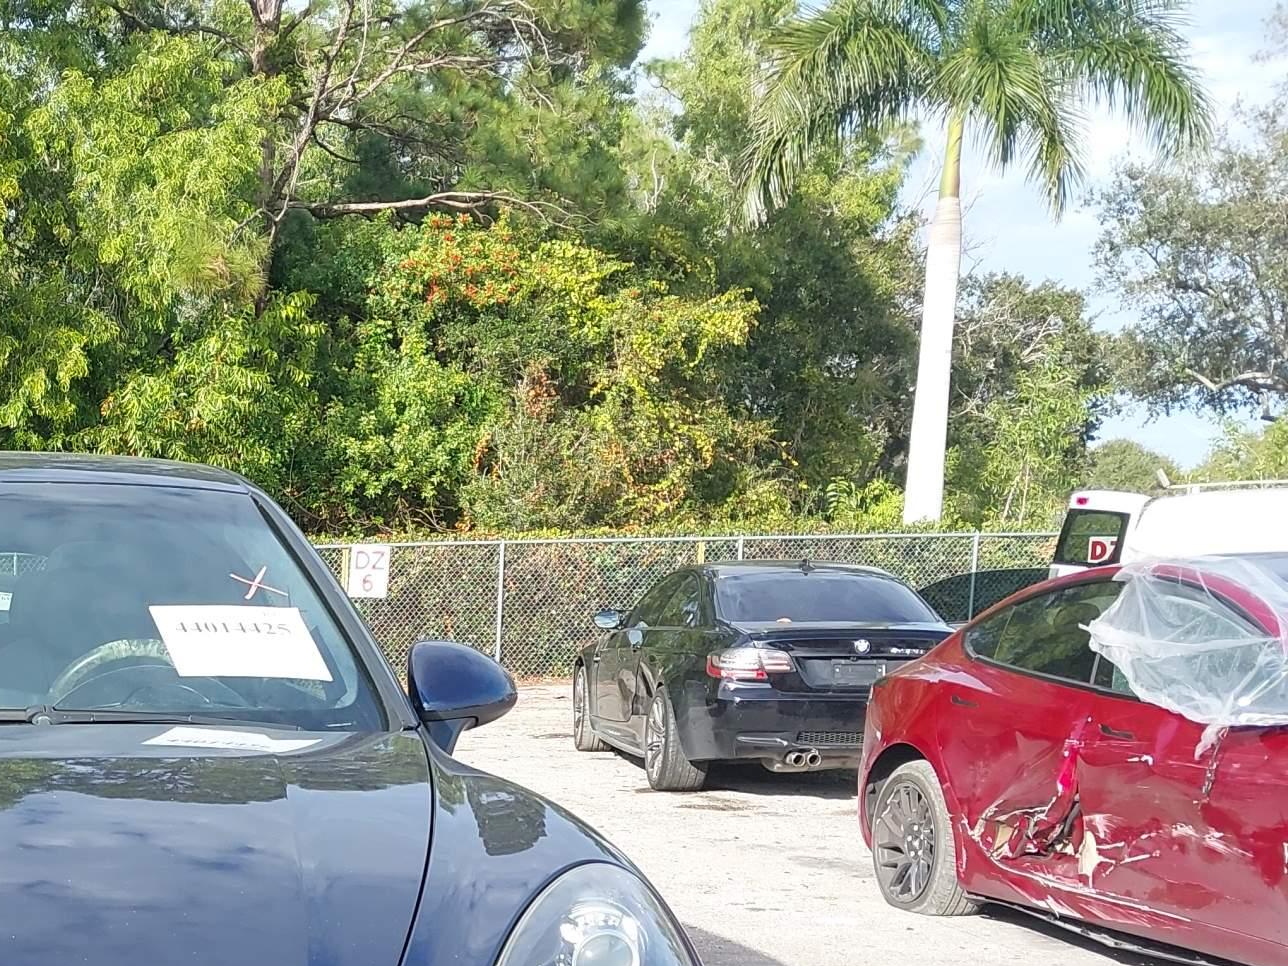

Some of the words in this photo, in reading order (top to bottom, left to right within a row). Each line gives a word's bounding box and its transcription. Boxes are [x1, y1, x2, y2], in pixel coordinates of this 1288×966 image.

[355, 550, 386, 570] DZ
[1089, 540, 1117, 561] D
[362, 573, 373, 593] 6
[174, 621, 292, 636] 44014425
